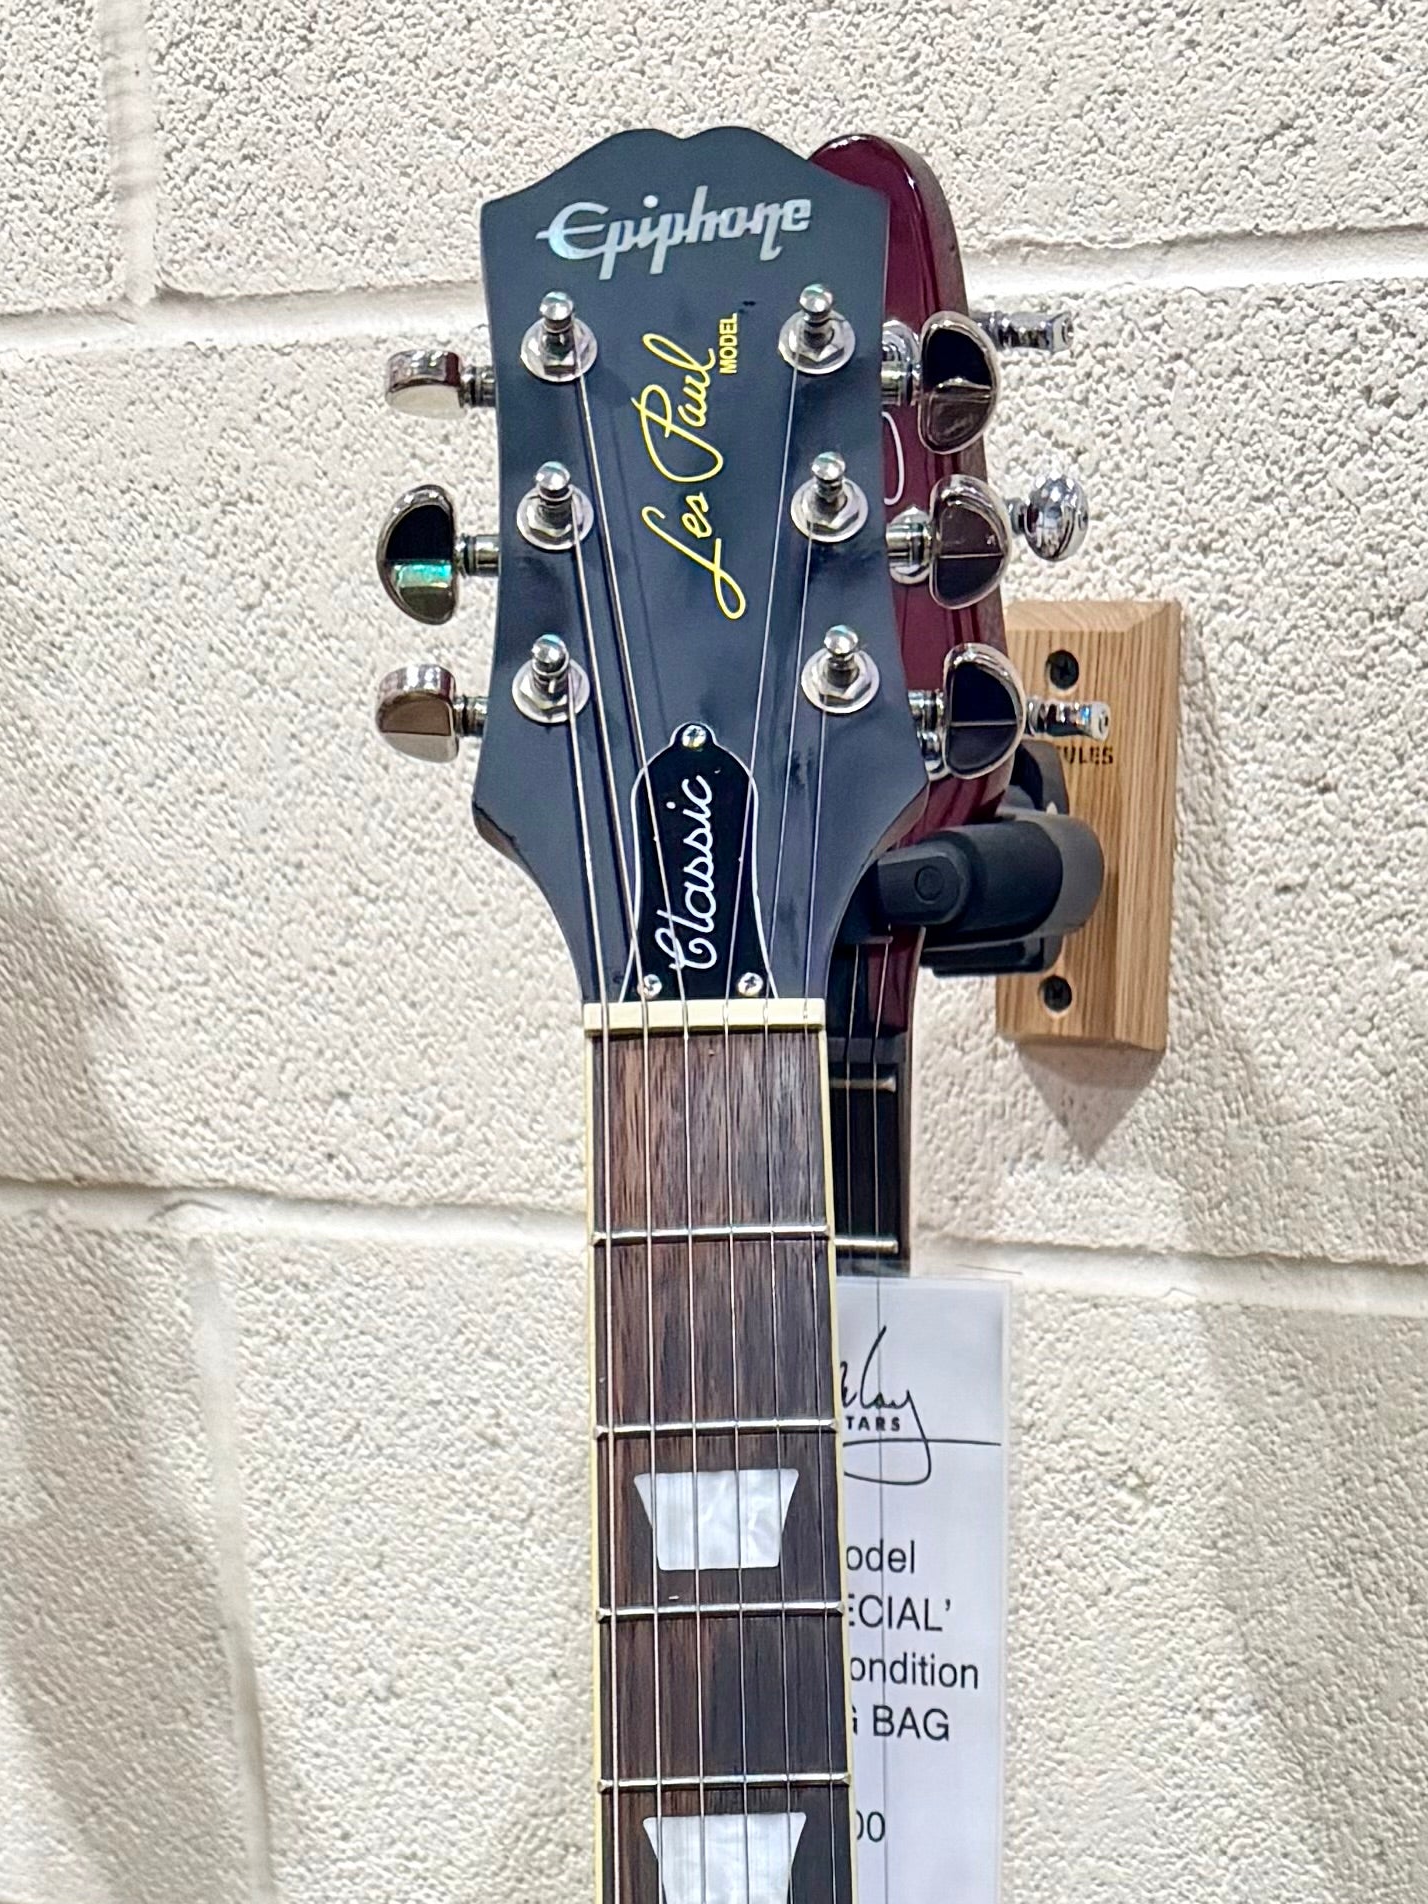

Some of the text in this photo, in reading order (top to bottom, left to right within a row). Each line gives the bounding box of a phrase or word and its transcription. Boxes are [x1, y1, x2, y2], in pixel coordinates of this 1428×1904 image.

[535, 185, 811, 280] Epiphone
[719, 313, 738, 374] MODEL
[630, 332, 746, 620] Les Paul
[1056, 746, 1113, 765] ULES
[655, 775, 717, 969] Classic
[845, 1416, 901, 1431] TARS
[846, 1538, 916, 1575] odel
[850, 1651, 979, 1690] ondition
[872, 1704, 950, 1742] BAG
